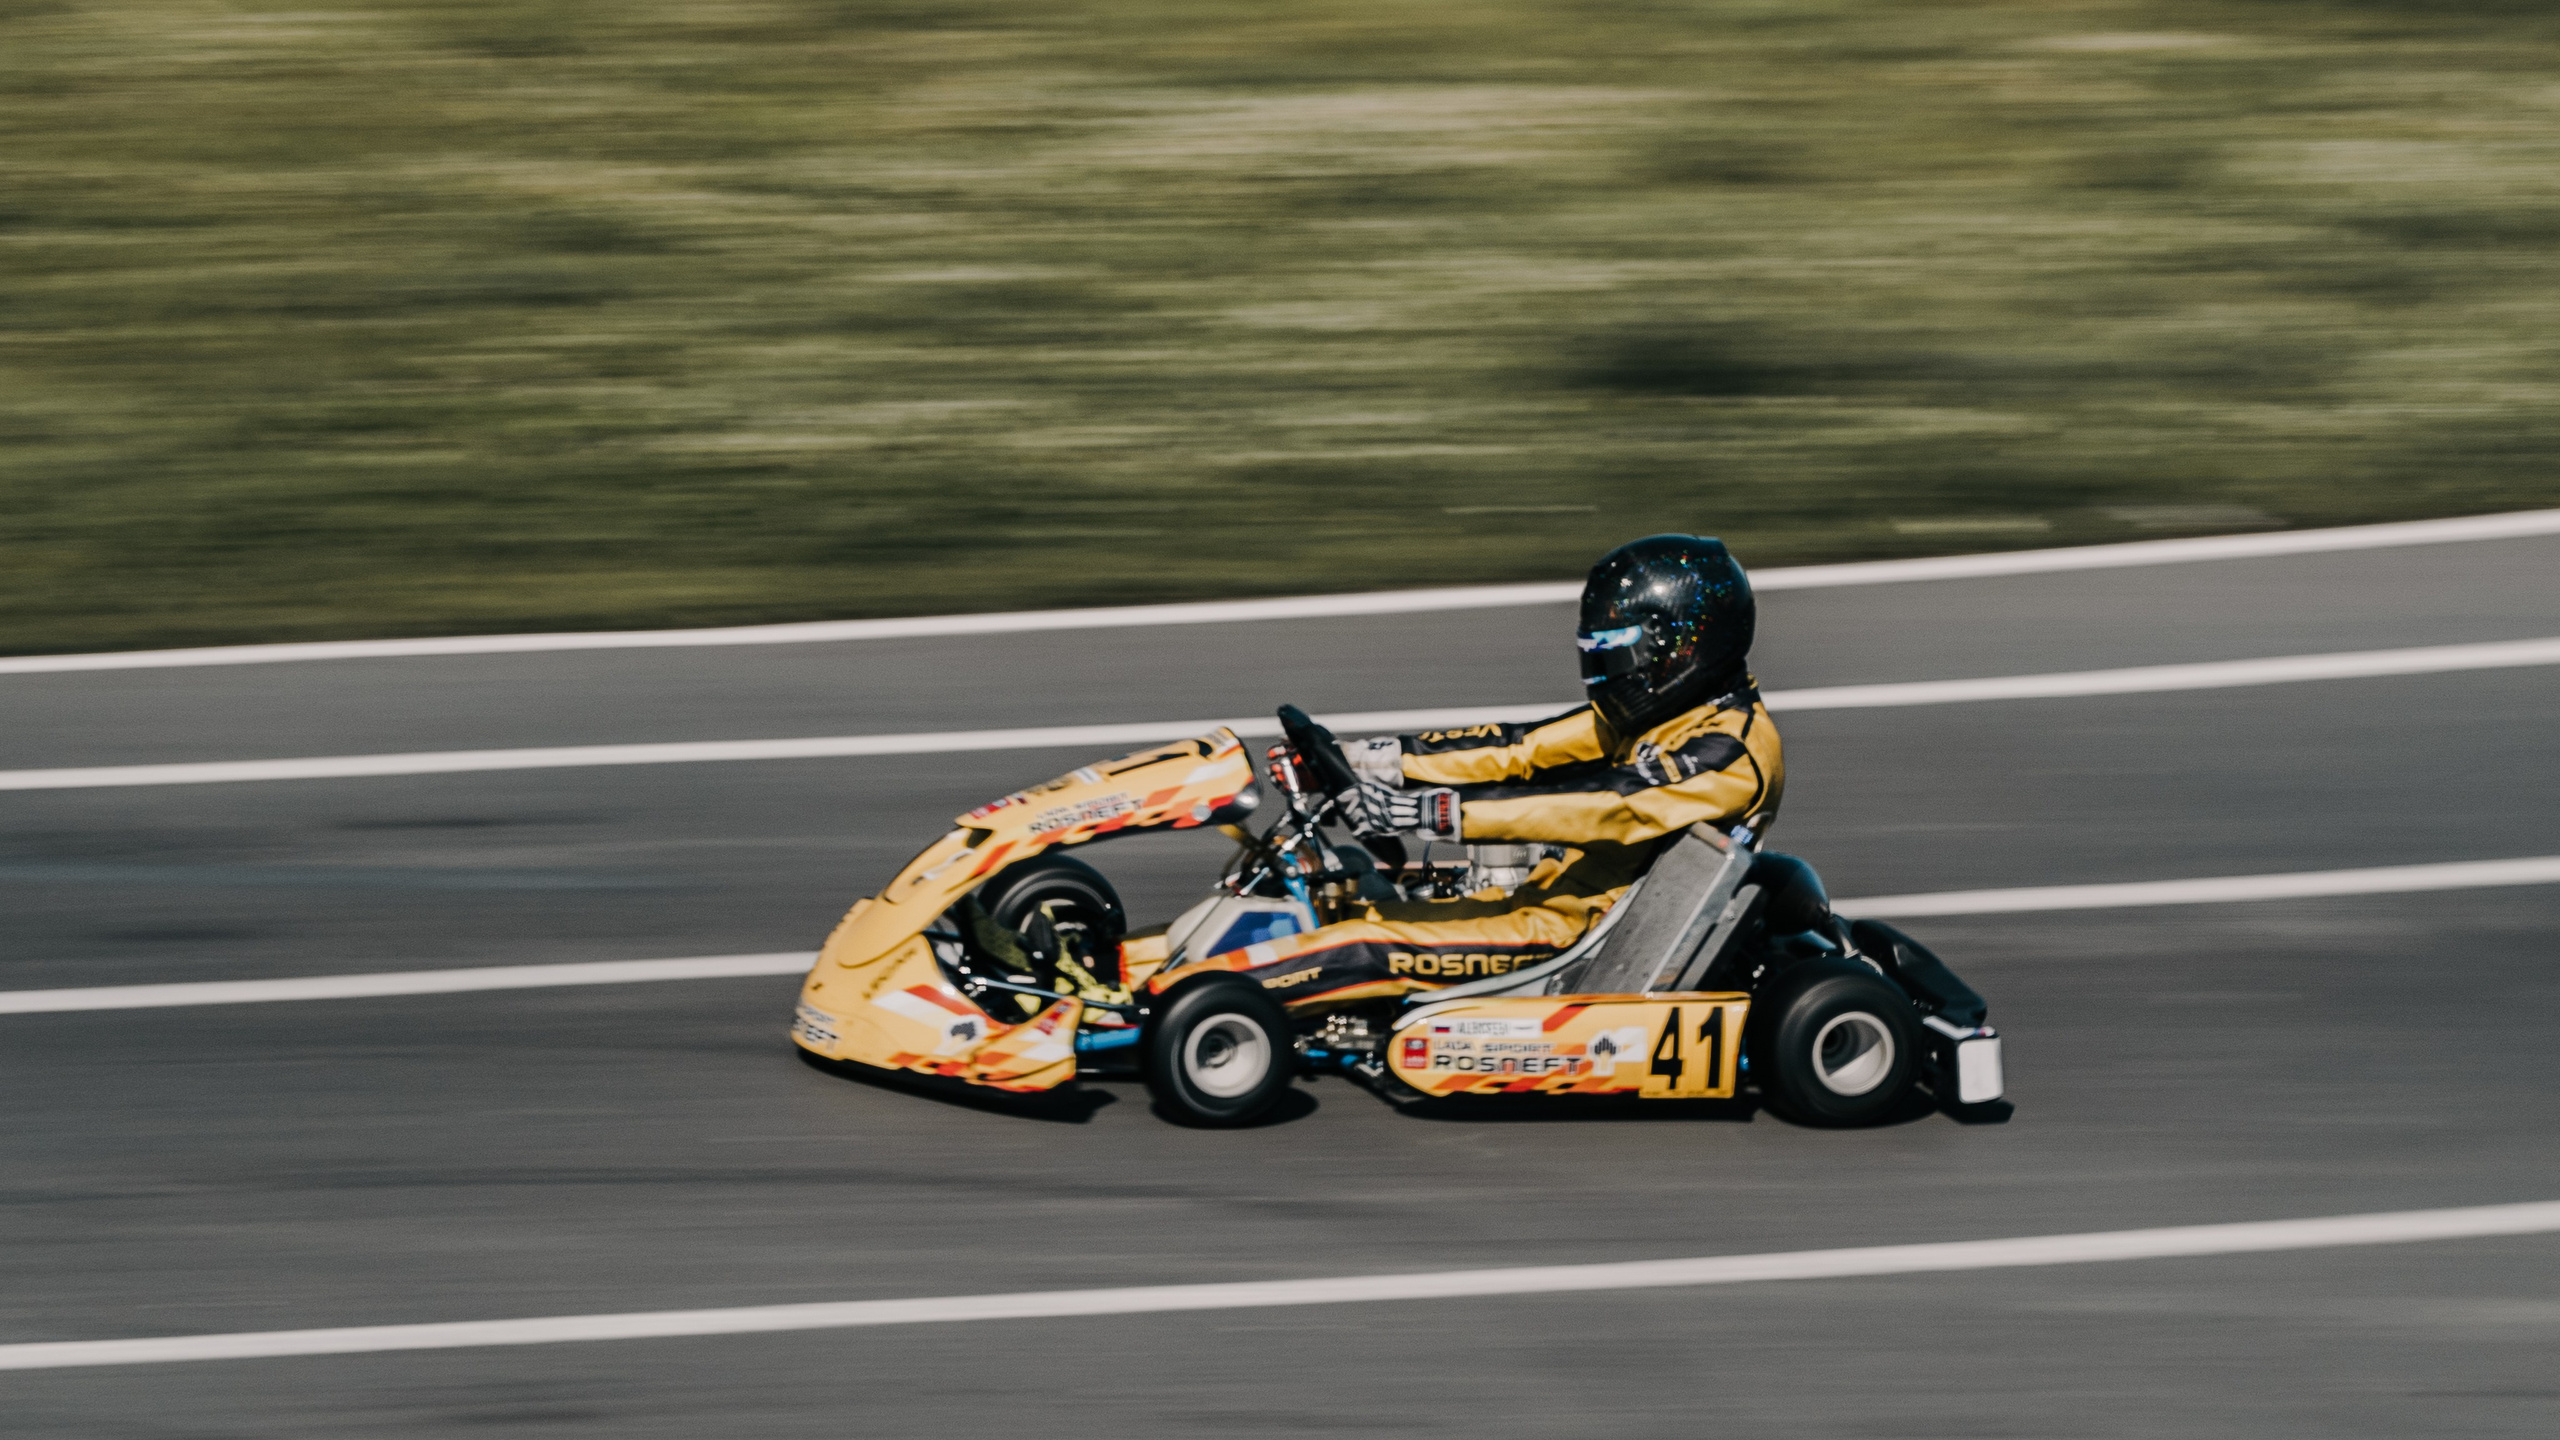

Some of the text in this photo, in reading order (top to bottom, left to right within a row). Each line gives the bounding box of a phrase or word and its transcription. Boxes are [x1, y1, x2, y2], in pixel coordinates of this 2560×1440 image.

[1029, 799, 1145, 833] ROSNEFT
[1435, 1054, 1581, 1074] ROSNEFT
[1650, 1006, 1723, 1090] 41
